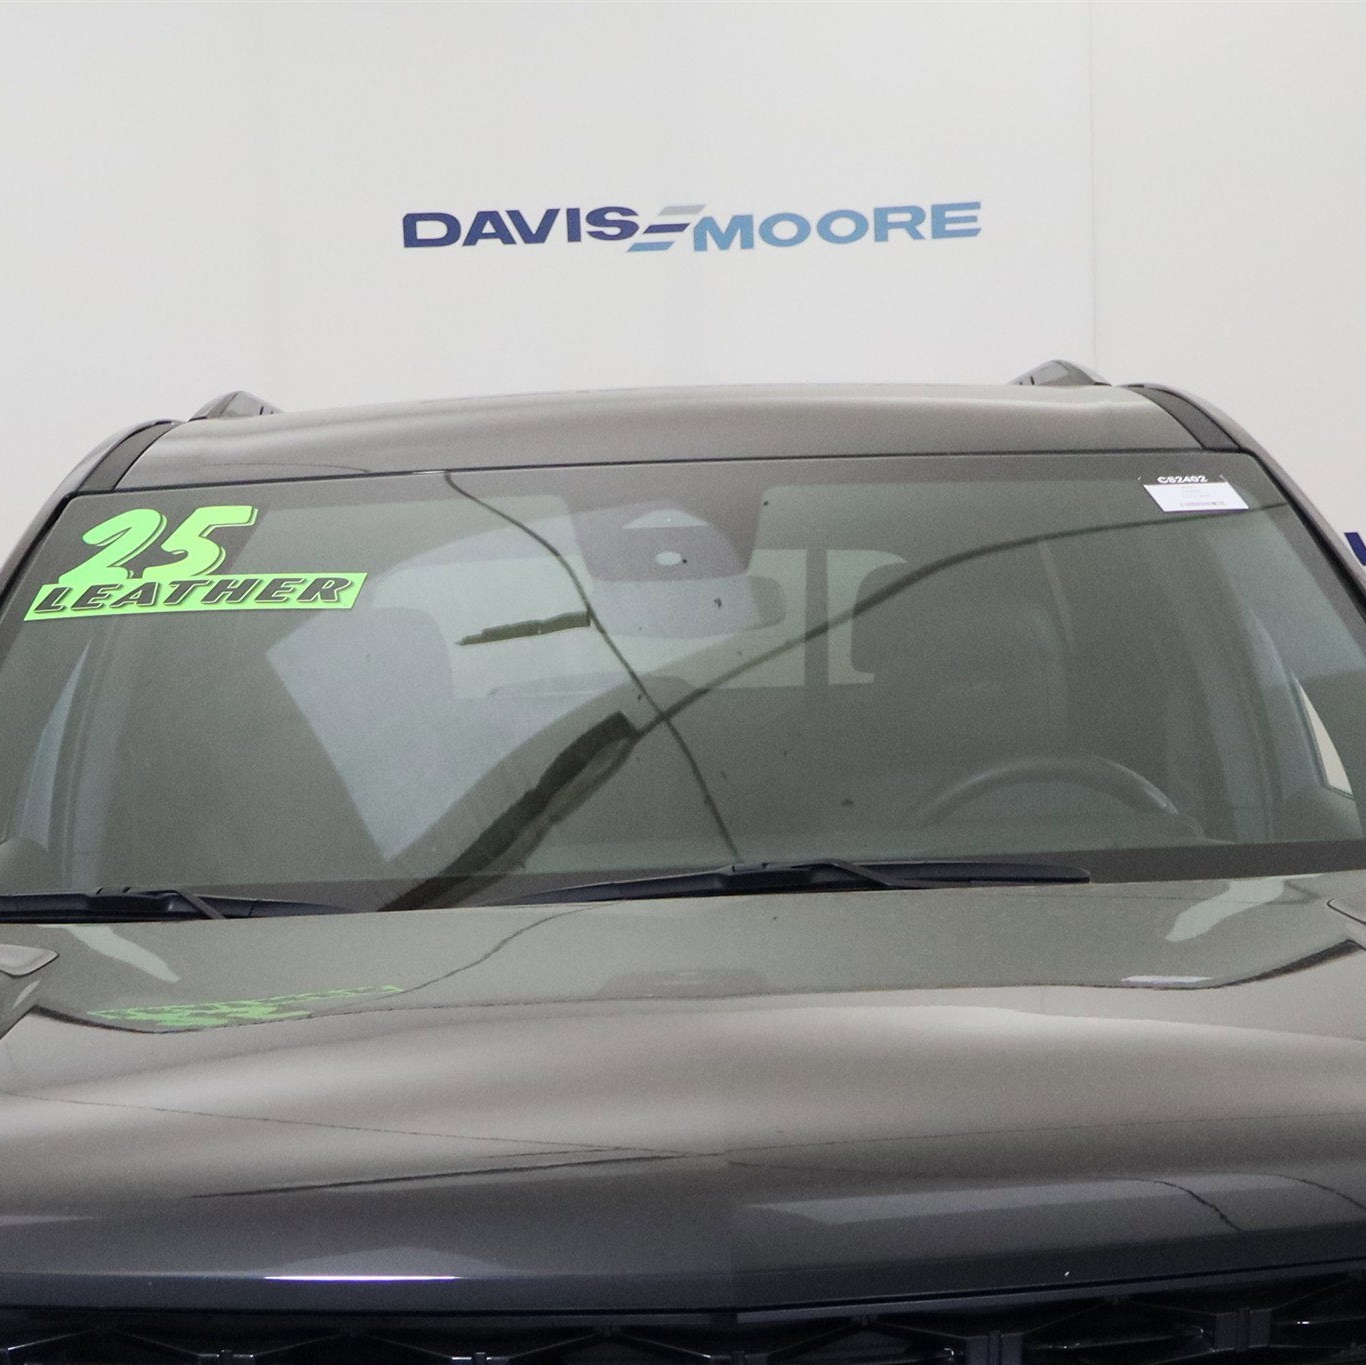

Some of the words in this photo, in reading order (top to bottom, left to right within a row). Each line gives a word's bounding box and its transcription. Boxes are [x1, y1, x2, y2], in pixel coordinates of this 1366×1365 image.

[401, 205, 640, 249] DAVIS
[692, 201, 982, 252] MOORE
[58, 505, 259, 580] 25
[34, 577, 352, 613] LEATHER
